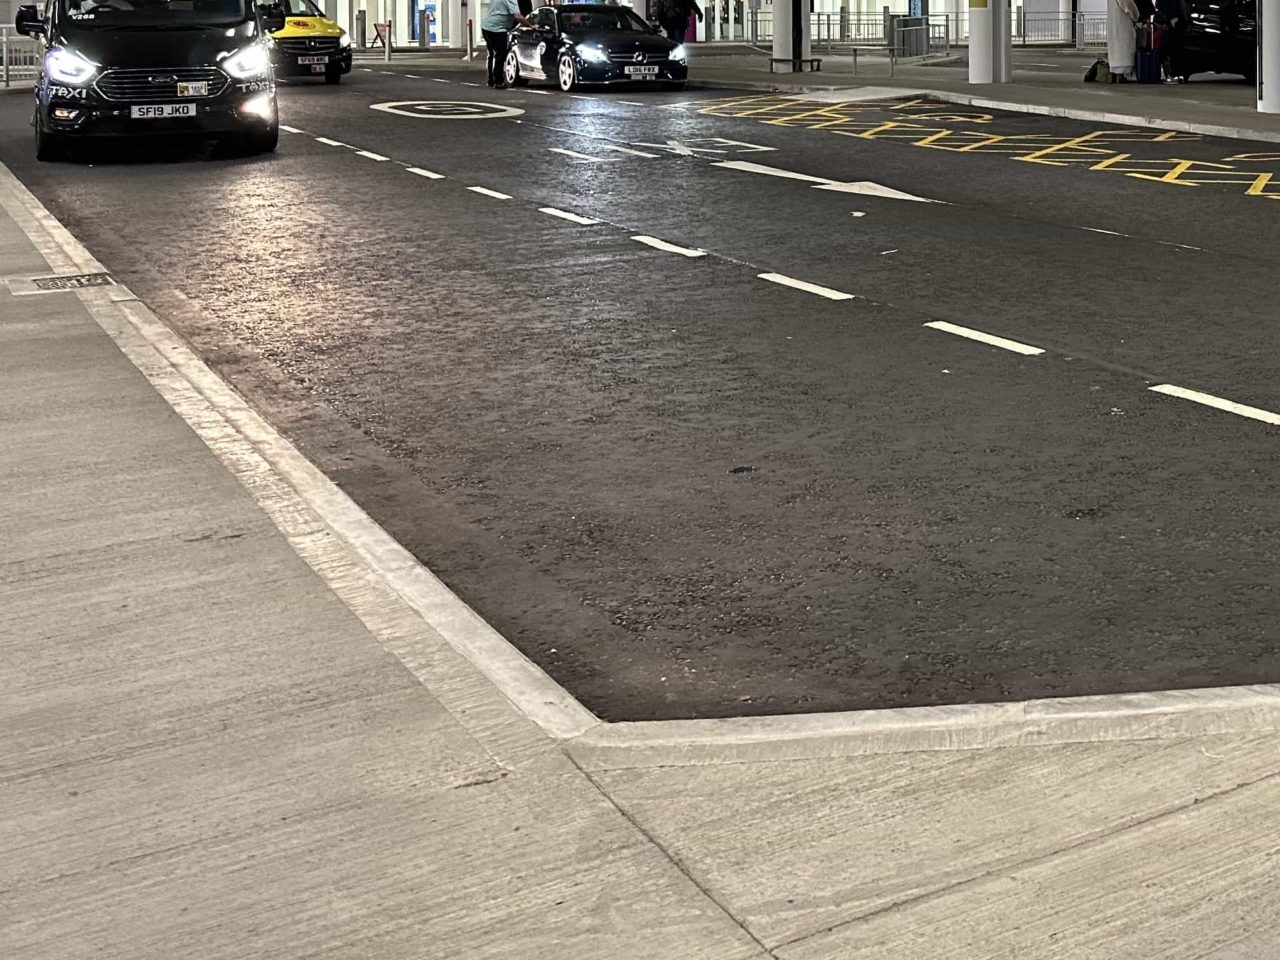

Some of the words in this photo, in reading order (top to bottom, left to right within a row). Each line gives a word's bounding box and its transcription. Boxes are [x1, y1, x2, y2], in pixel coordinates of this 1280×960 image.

[48, 85, 87, 99] TAXI
[137, 107, 164, 118] SF19
[167, 106, 190, 117] JKO
